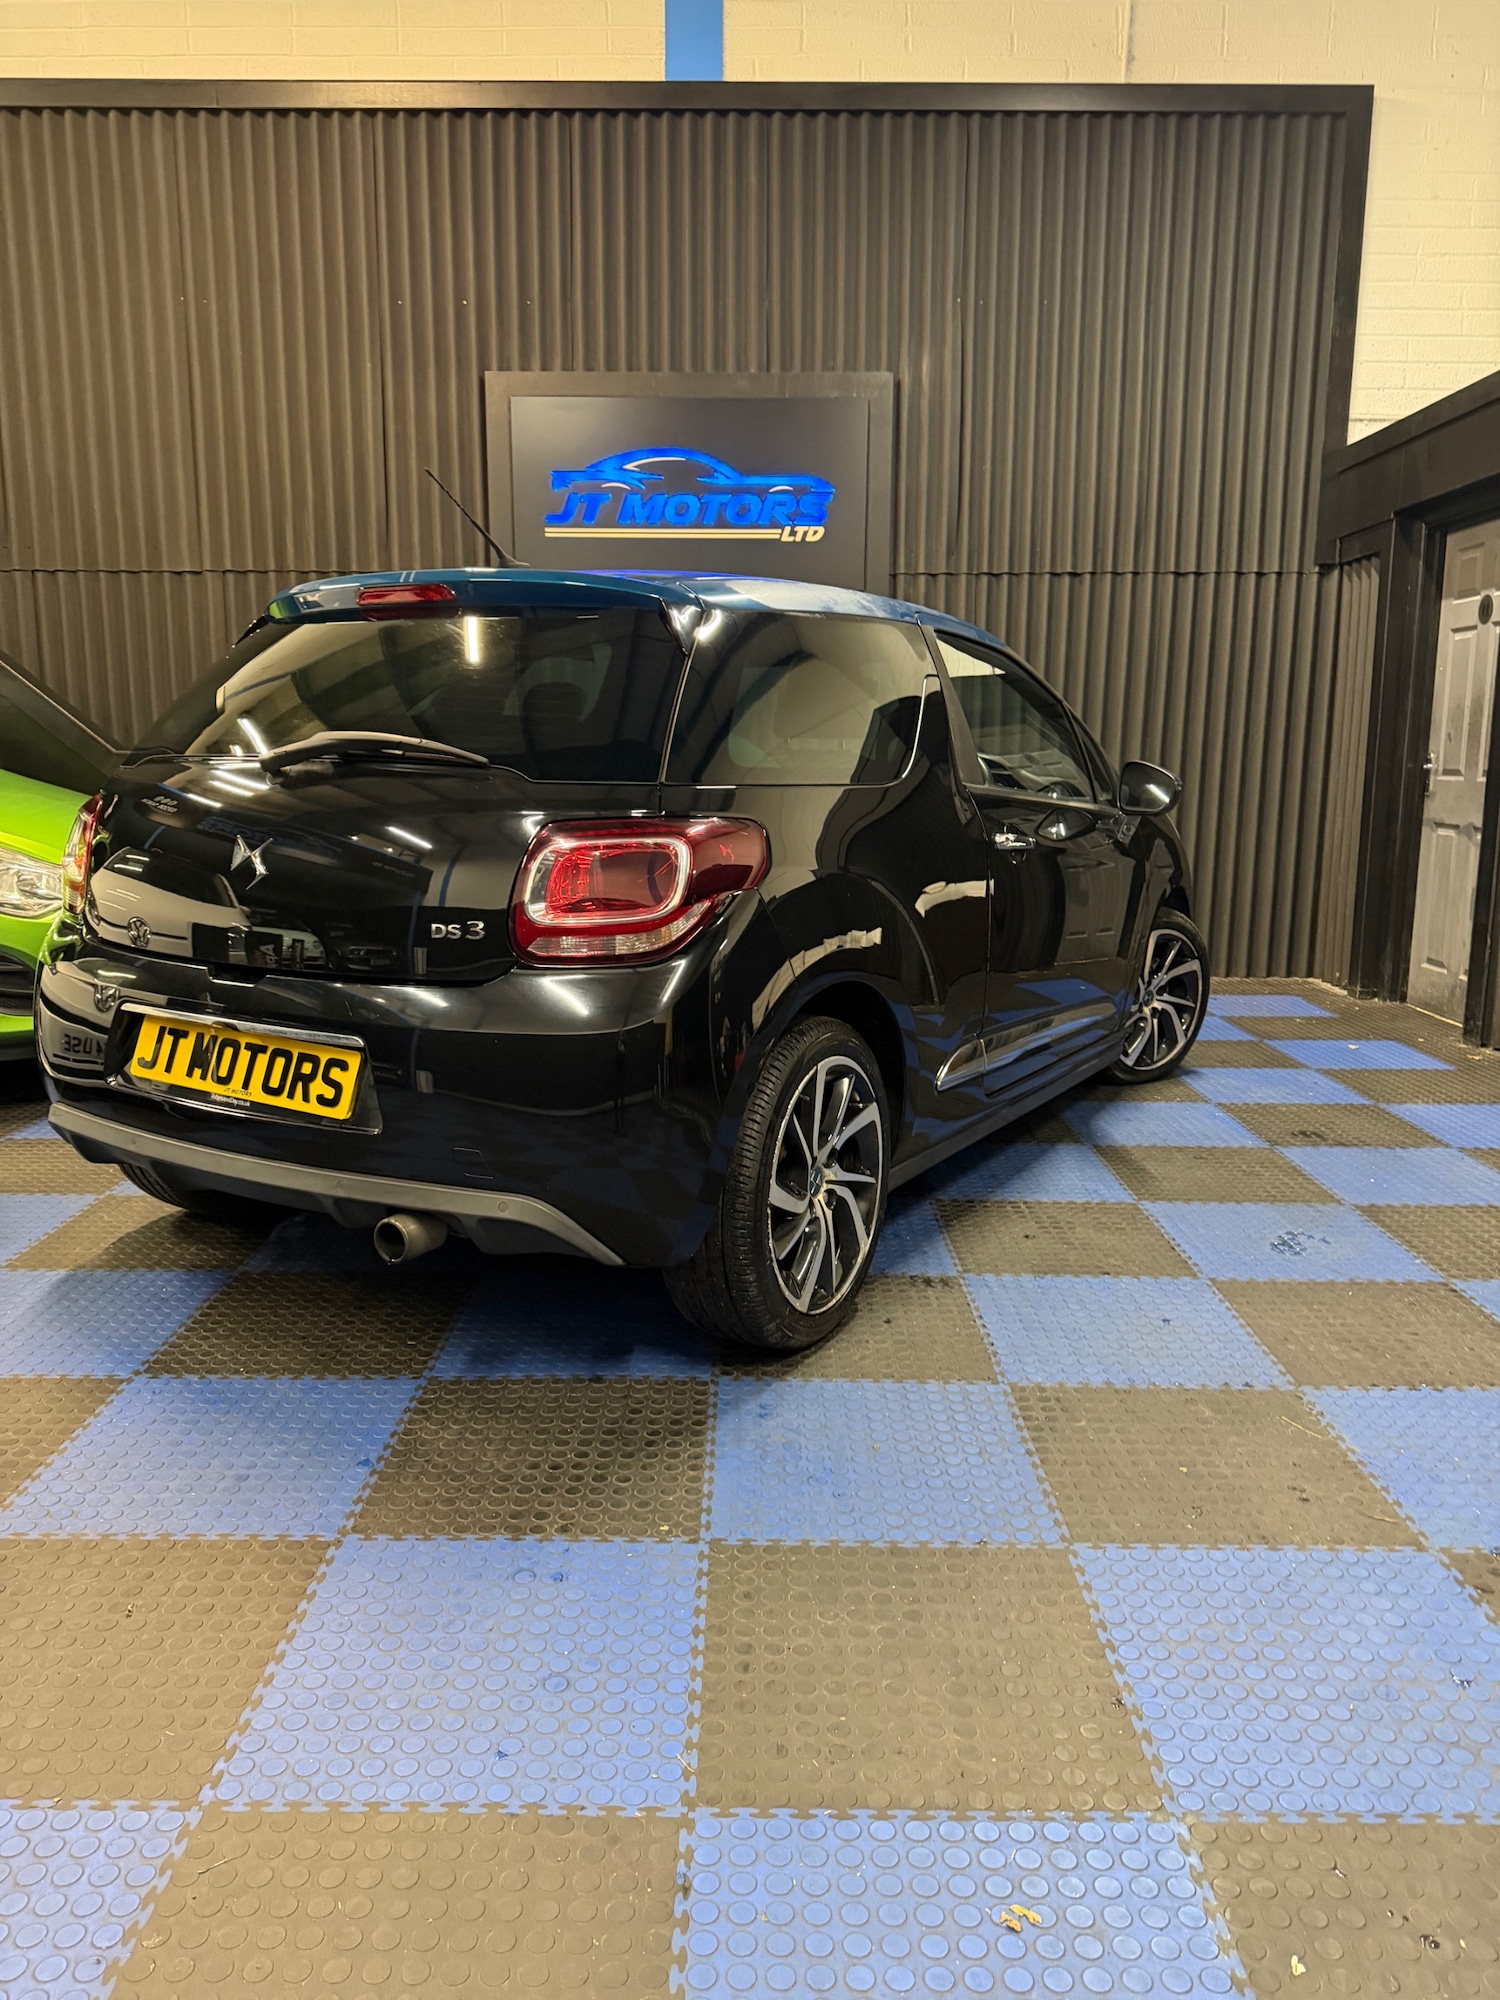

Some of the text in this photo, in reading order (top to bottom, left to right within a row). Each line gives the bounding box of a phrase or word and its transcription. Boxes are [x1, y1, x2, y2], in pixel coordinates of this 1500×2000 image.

[544, 492, 834, 526] JT MOTORS
[780, 525, 826, 543] LTD
[430, 920, 486, 940] DS 3
[137, 1025, 350, 1109] JT MOTORS
